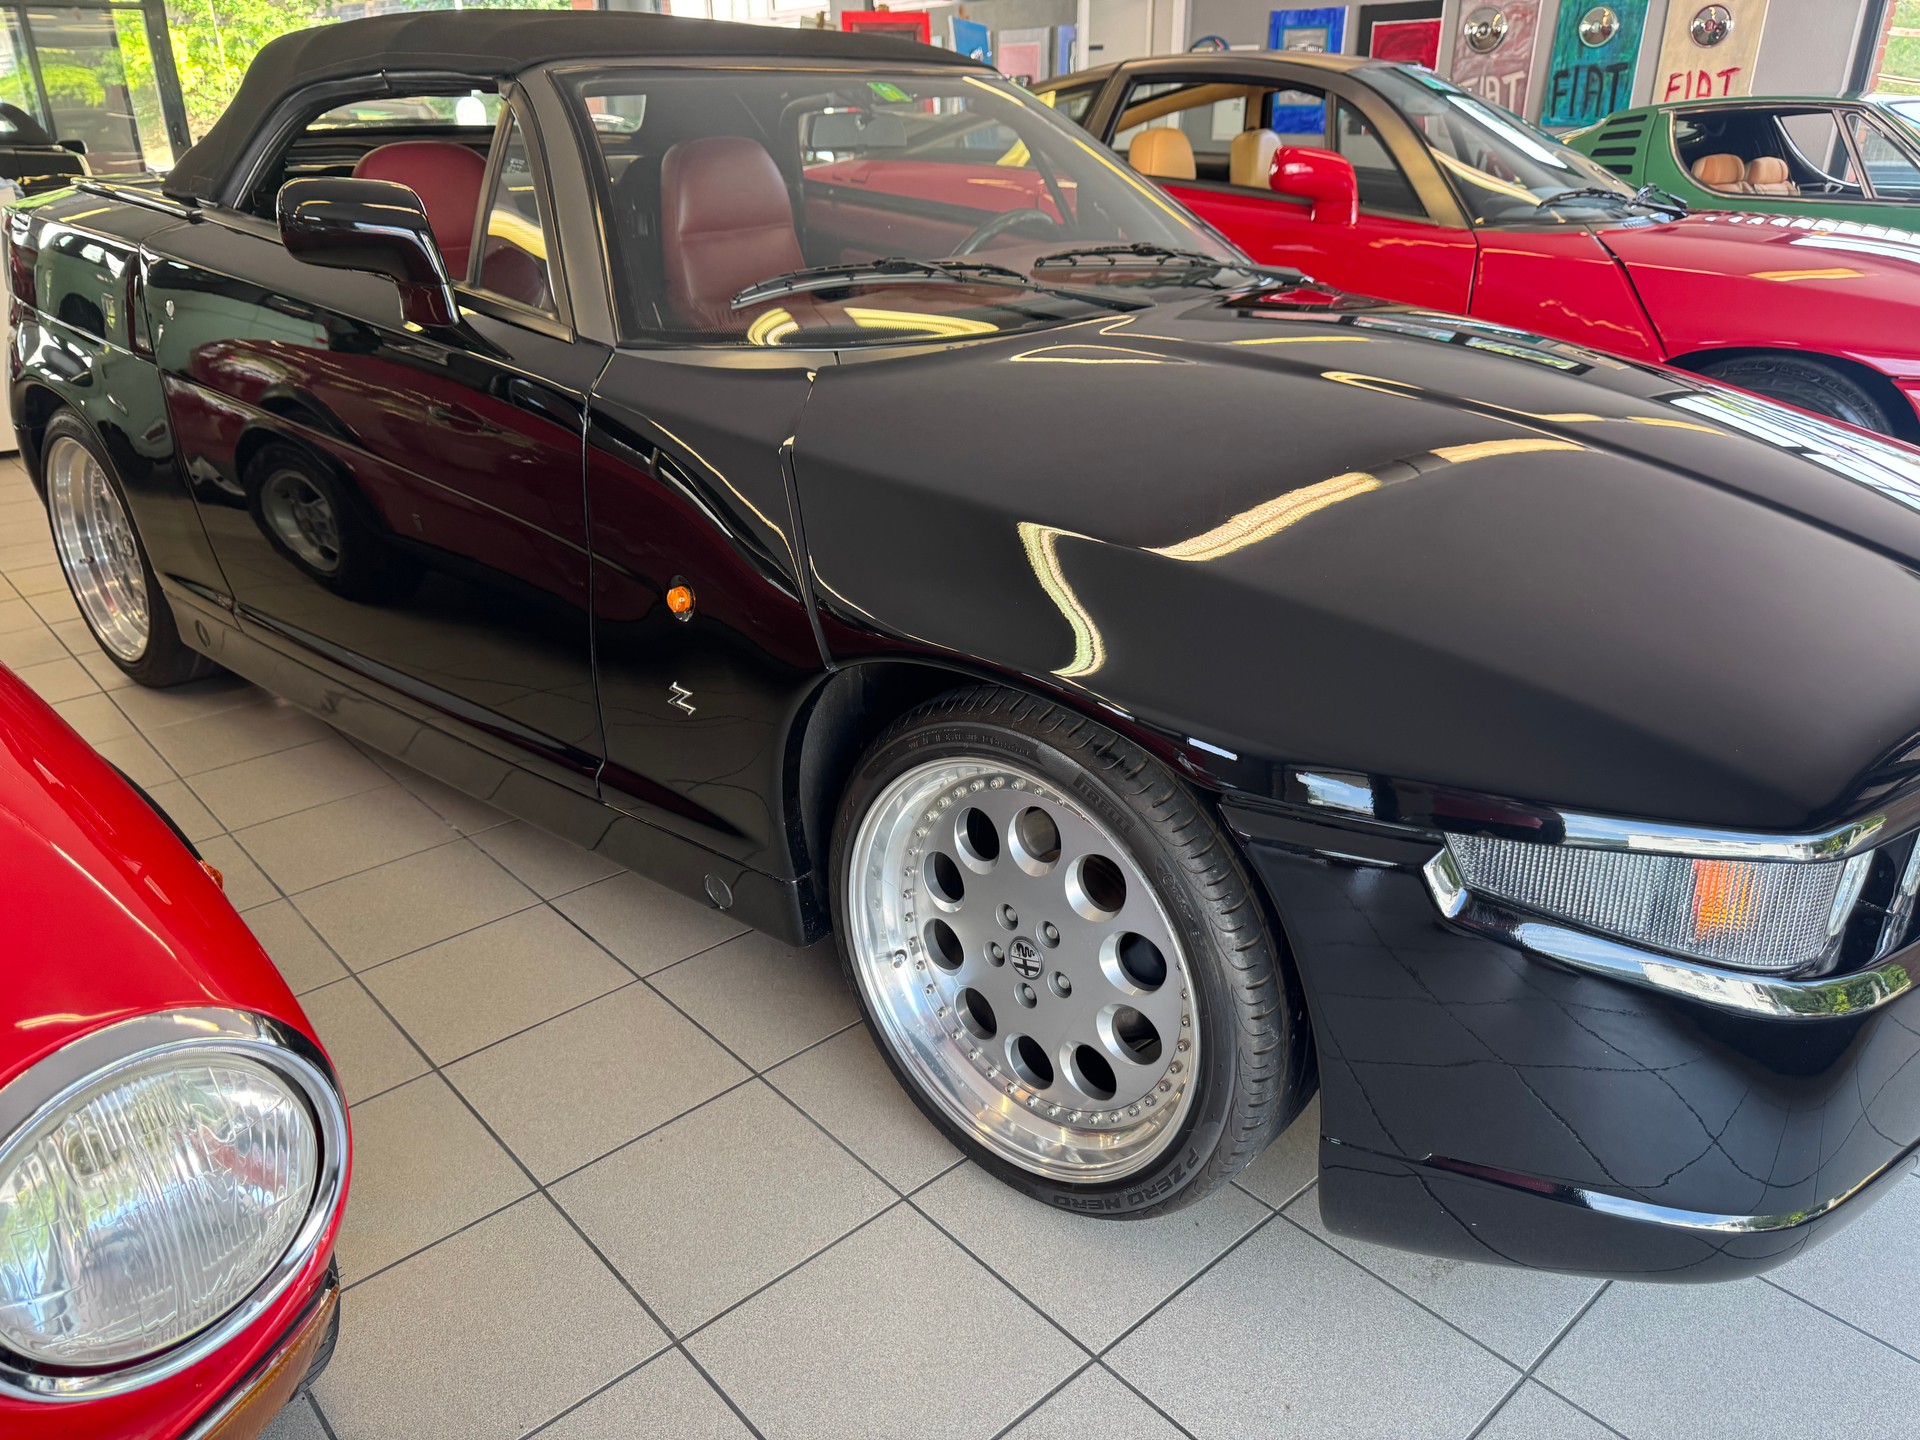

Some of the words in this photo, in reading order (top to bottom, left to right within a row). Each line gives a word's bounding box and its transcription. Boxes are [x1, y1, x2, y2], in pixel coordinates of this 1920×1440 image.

[1550, 62, 1628, 118] FIAT
[1664, 67, 1741, 102] FIAT
[1073, 772, 1136, 833] PIRELLI
[1053, 1195, 1122, 1211] NERO
